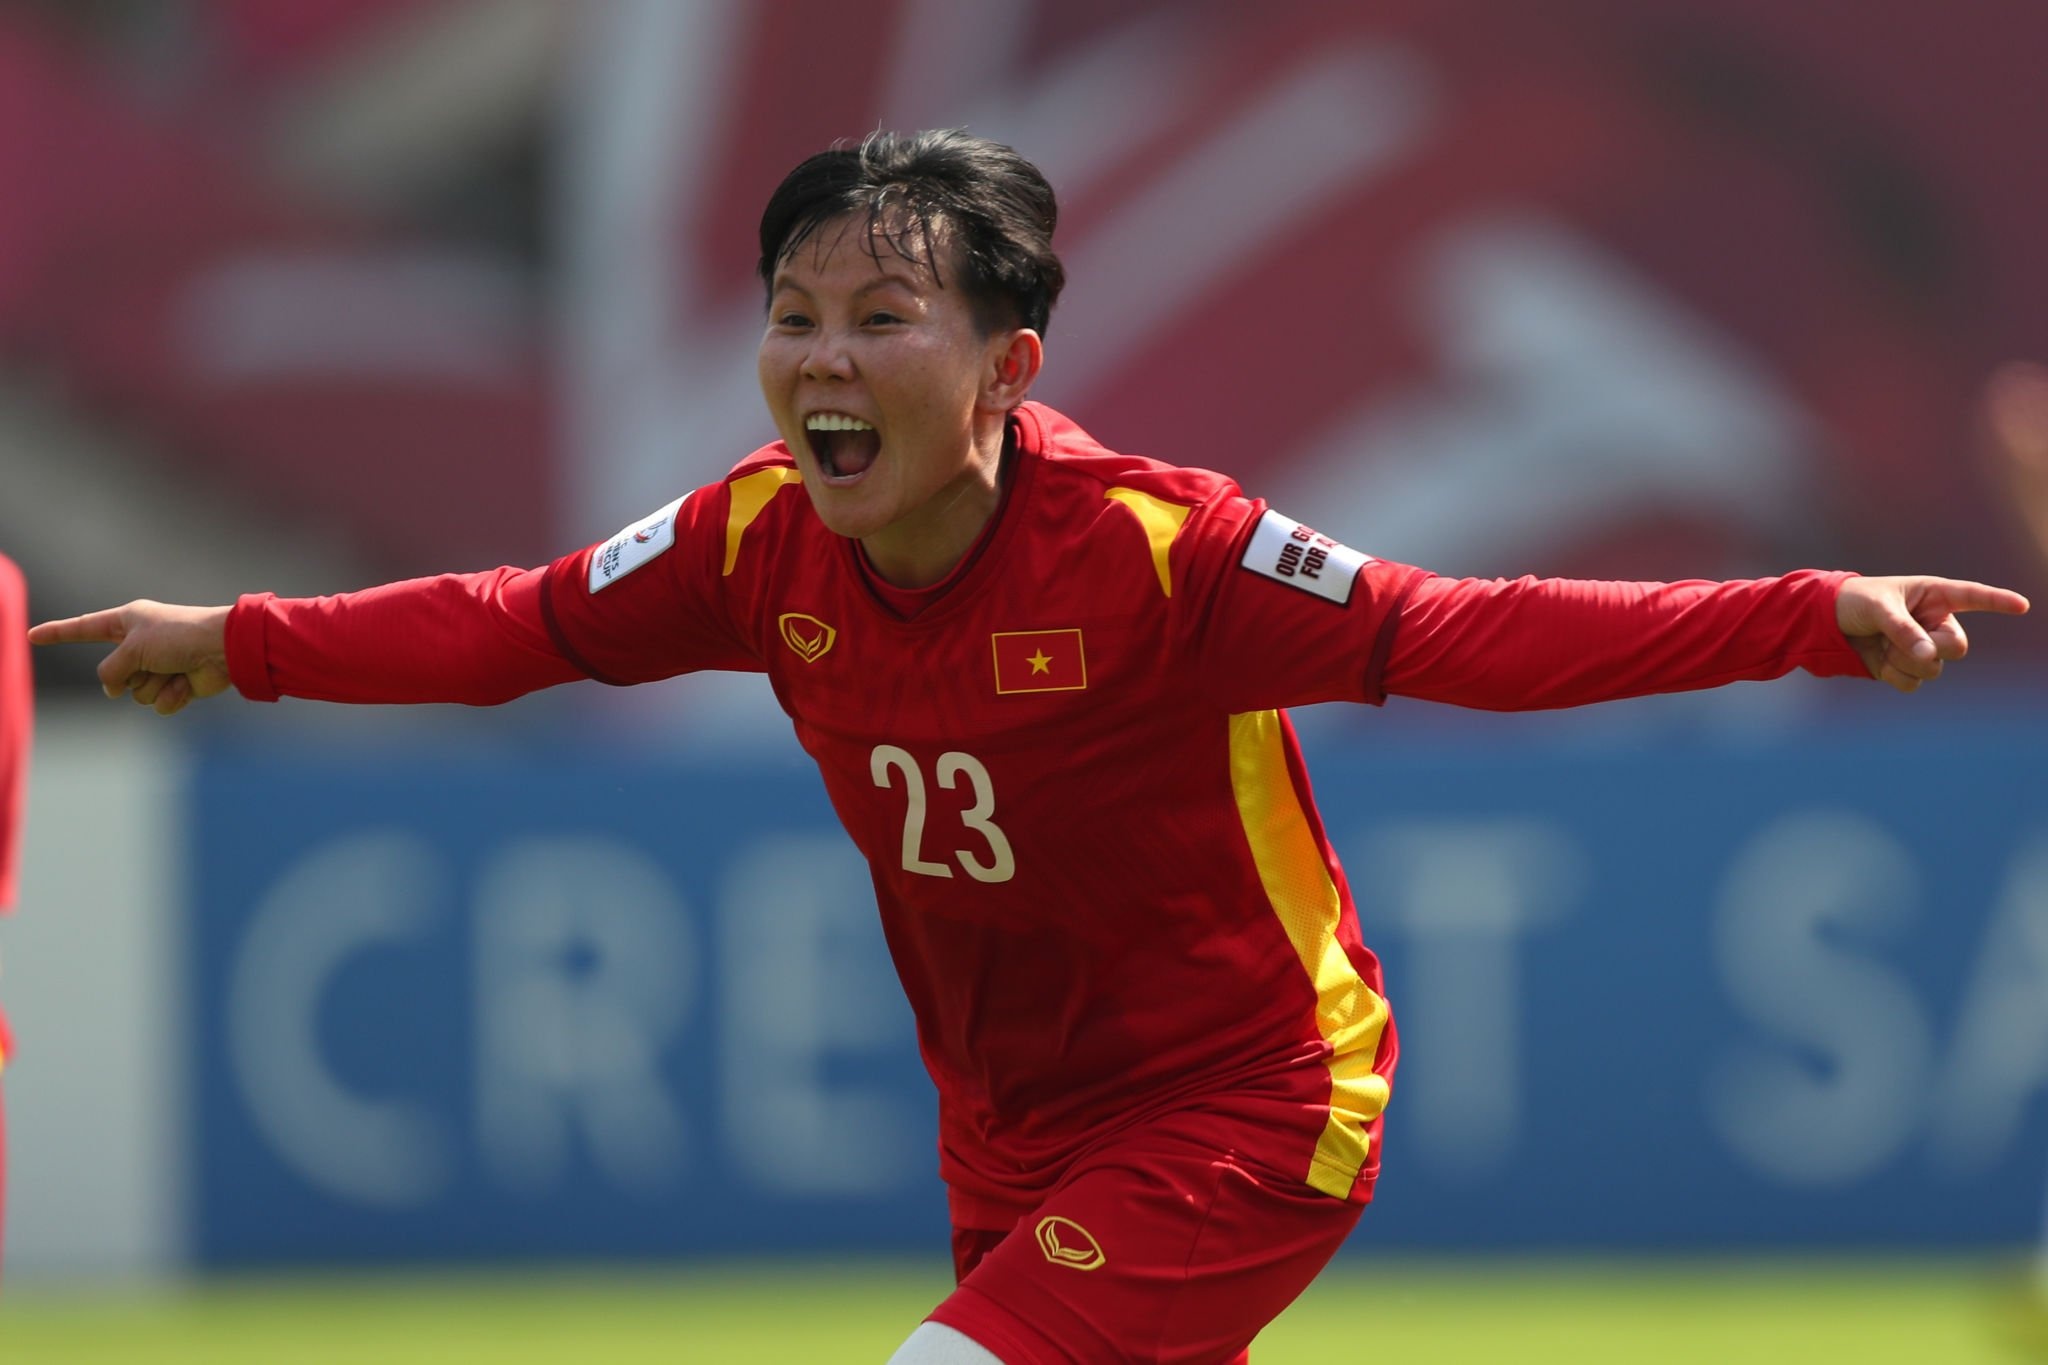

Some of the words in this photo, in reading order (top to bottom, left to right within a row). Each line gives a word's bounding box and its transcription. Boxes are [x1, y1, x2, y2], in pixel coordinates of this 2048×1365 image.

[1276, 543, 1304, 577] OUR
[1300, 547, 1328, 579] FOR
[871, 744, 1016, 884] 23
[230, 822, 1587, 1204] CRET
